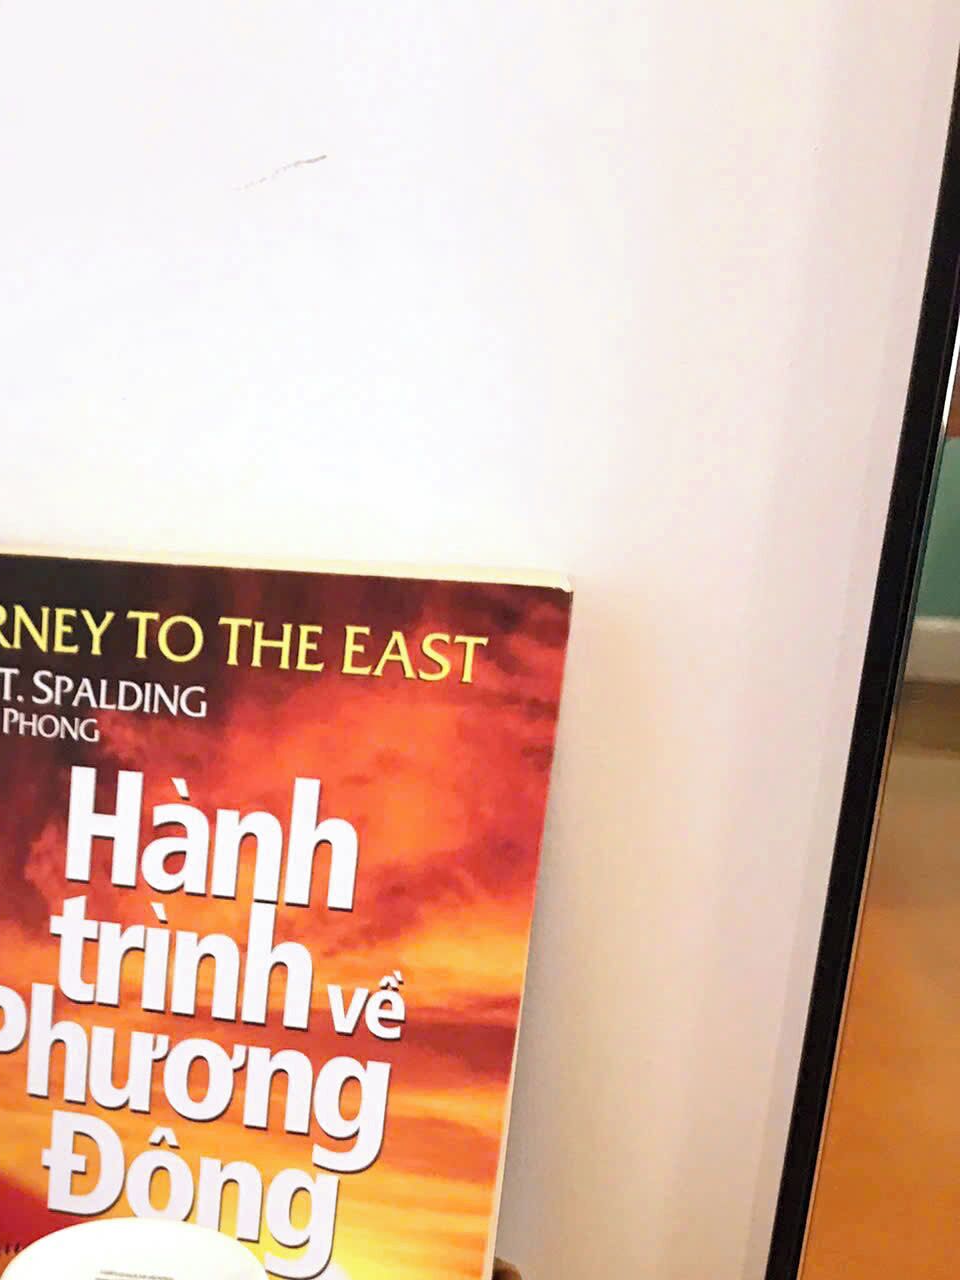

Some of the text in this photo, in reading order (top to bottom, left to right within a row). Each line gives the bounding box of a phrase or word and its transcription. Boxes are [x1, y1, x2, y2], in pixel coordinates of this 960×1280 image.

[126, 612, 205, 664] TO
[219, 617, 325, 674] THE
[341, 626, 489, 684] EAST
[3, 707, 100, 743] PHONG
[32, 668, 208, 718] SPALDING
[64, 764, 360, 911] Hành
[50, 894, 407, 1040] trình về
